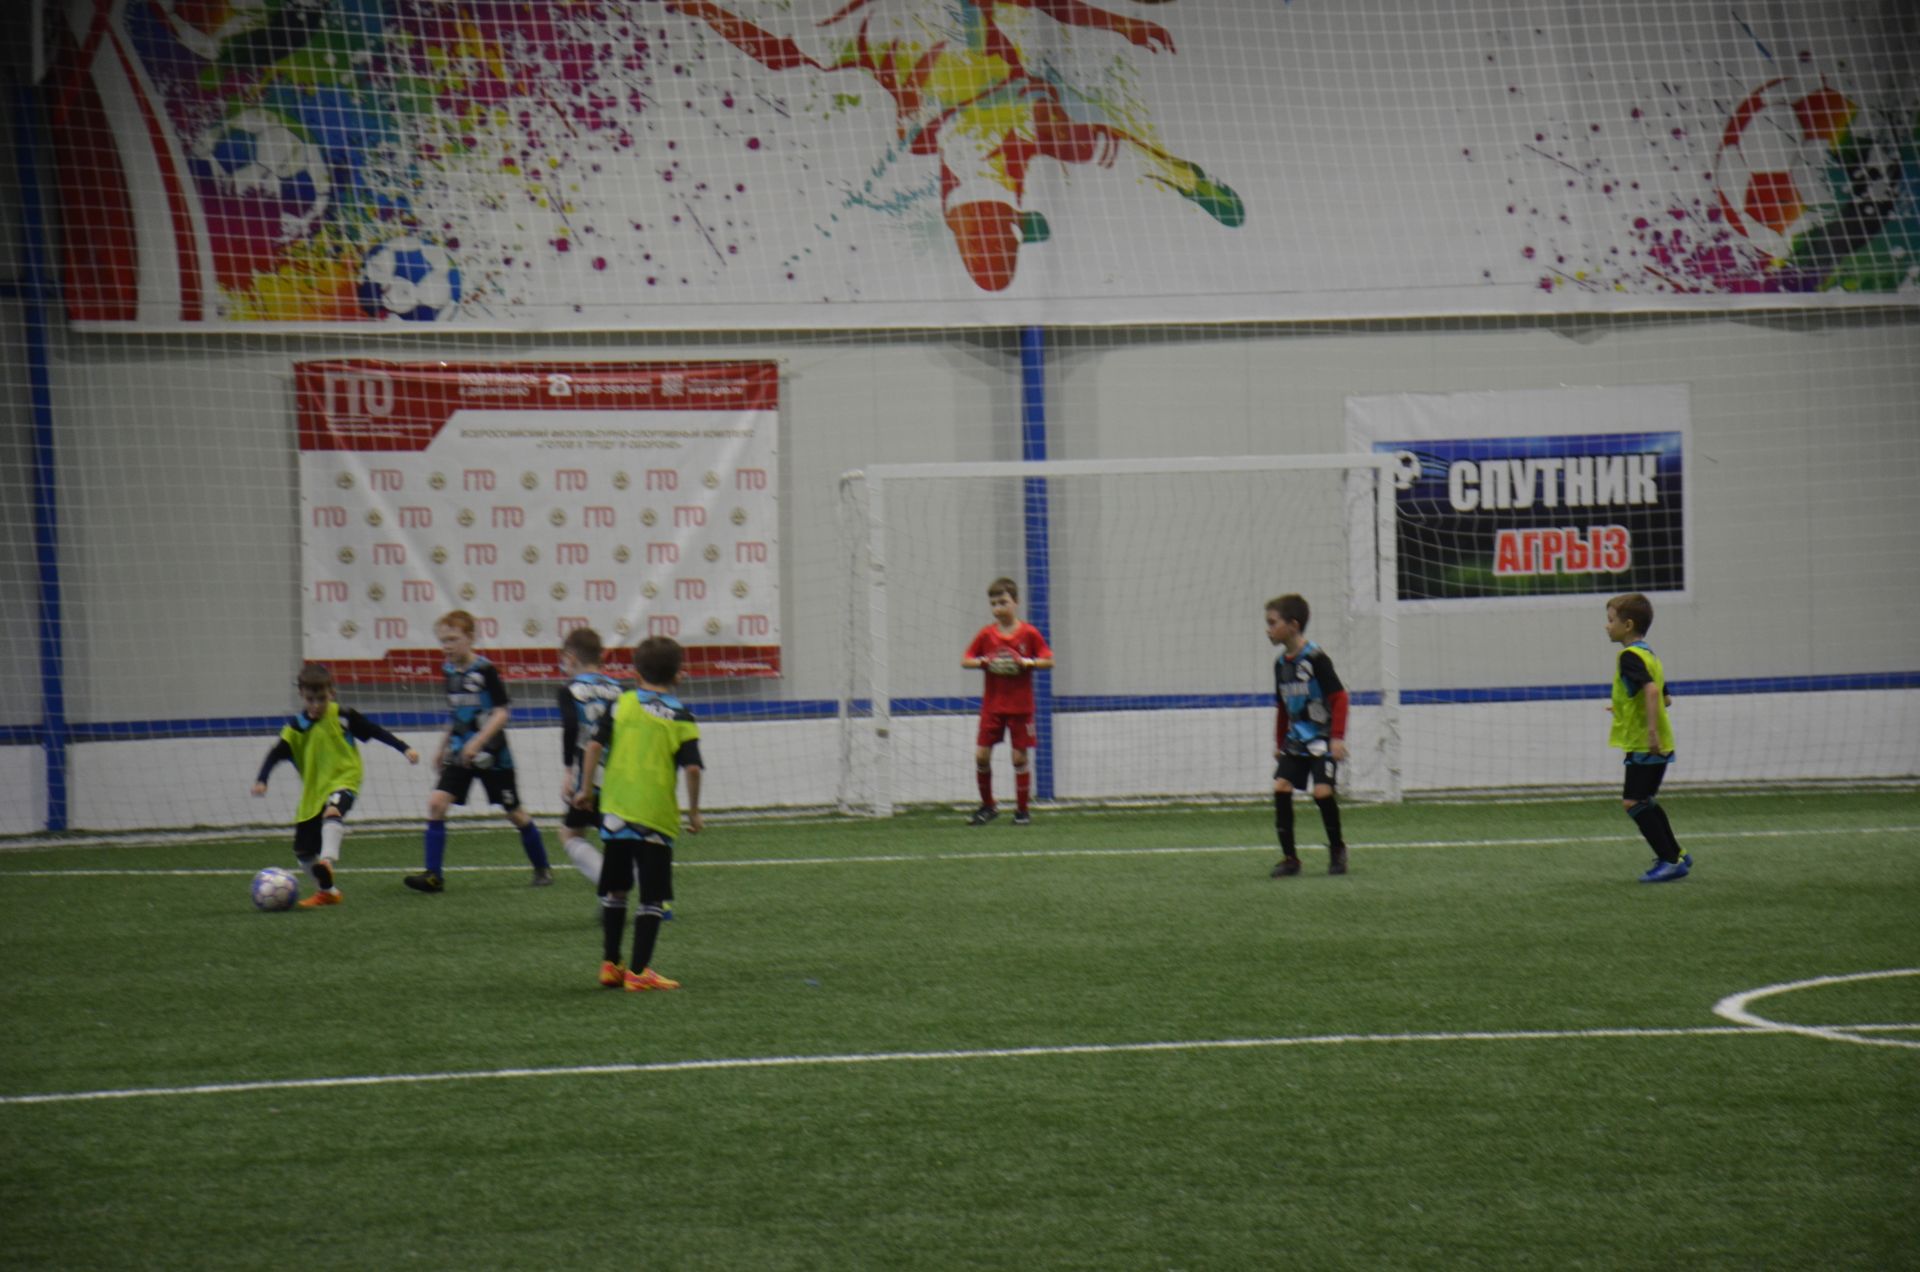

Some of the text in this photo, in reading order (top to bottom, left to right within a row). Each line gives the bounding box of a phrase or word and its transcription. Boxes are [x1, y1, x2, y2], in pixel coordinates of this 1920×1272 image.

[323, 370, 395, 418] ГТО
[371, 468, 403, 491] ГТО
[463, 468, 496, 491] ГТО
[555, 468, 588, 491] ГТО
[646, 468, 678, 491] ГТО
[736, 467, 768, 490] ГТО
[1448, 452, 1660, 512] СПУТНИК
[313, 506, 347, 528] ГТО
[399, 506, 432, 528] ГТО
[492, 506, 524, 528] ГТО
[583, 505, 615, 528] ГТО
[673, 505, 706, 527] ГТО
[373, 543, 406, 565] ГТО
[464, 543, 496, 565] ГТО
[556, 543, 589, 565] ГТО
[647, 542, 679, 564] ГТО
[736, 540, 768, 563] ГТО
[1494, 526, 1630, 575] АГРЫЗ
[315, 580, 348, 602] ГТО
[402, 579, 435, 602] ГТО
[493, 579, 525, 602] ГТО
[585, 578, 616, 601] ГТО
[674, 577, 706, 600] ГТО
[375, 616, 408, 640] ГТО
[474, 616, 499, 639] ТО
[737, 613, 769, 636] ГТО
